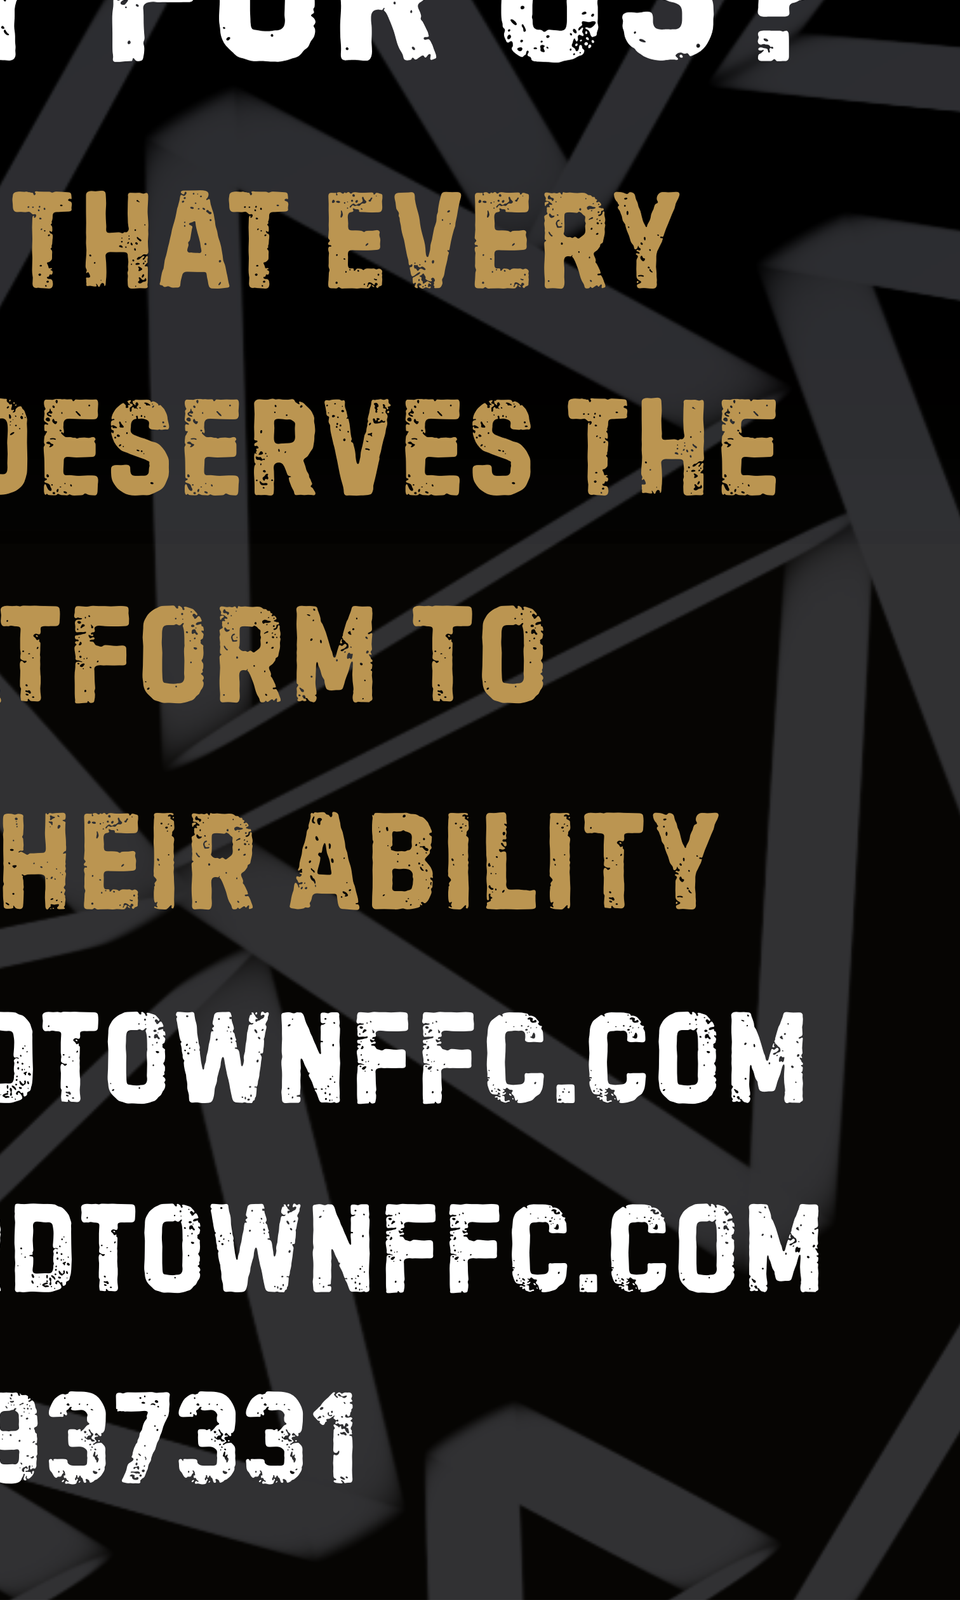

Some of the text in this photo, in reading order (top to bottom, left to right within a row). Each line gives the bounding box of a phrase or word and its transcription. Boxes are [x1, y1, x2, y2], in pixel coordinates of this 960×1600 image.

[13, 190, 288, 288] THAT
[328, 191, 679, 288] EVERY
[568, 398, 776, 495] THE
[413, 605, 543, 703] TO
[290, 812, 718, 910] ABILITY
